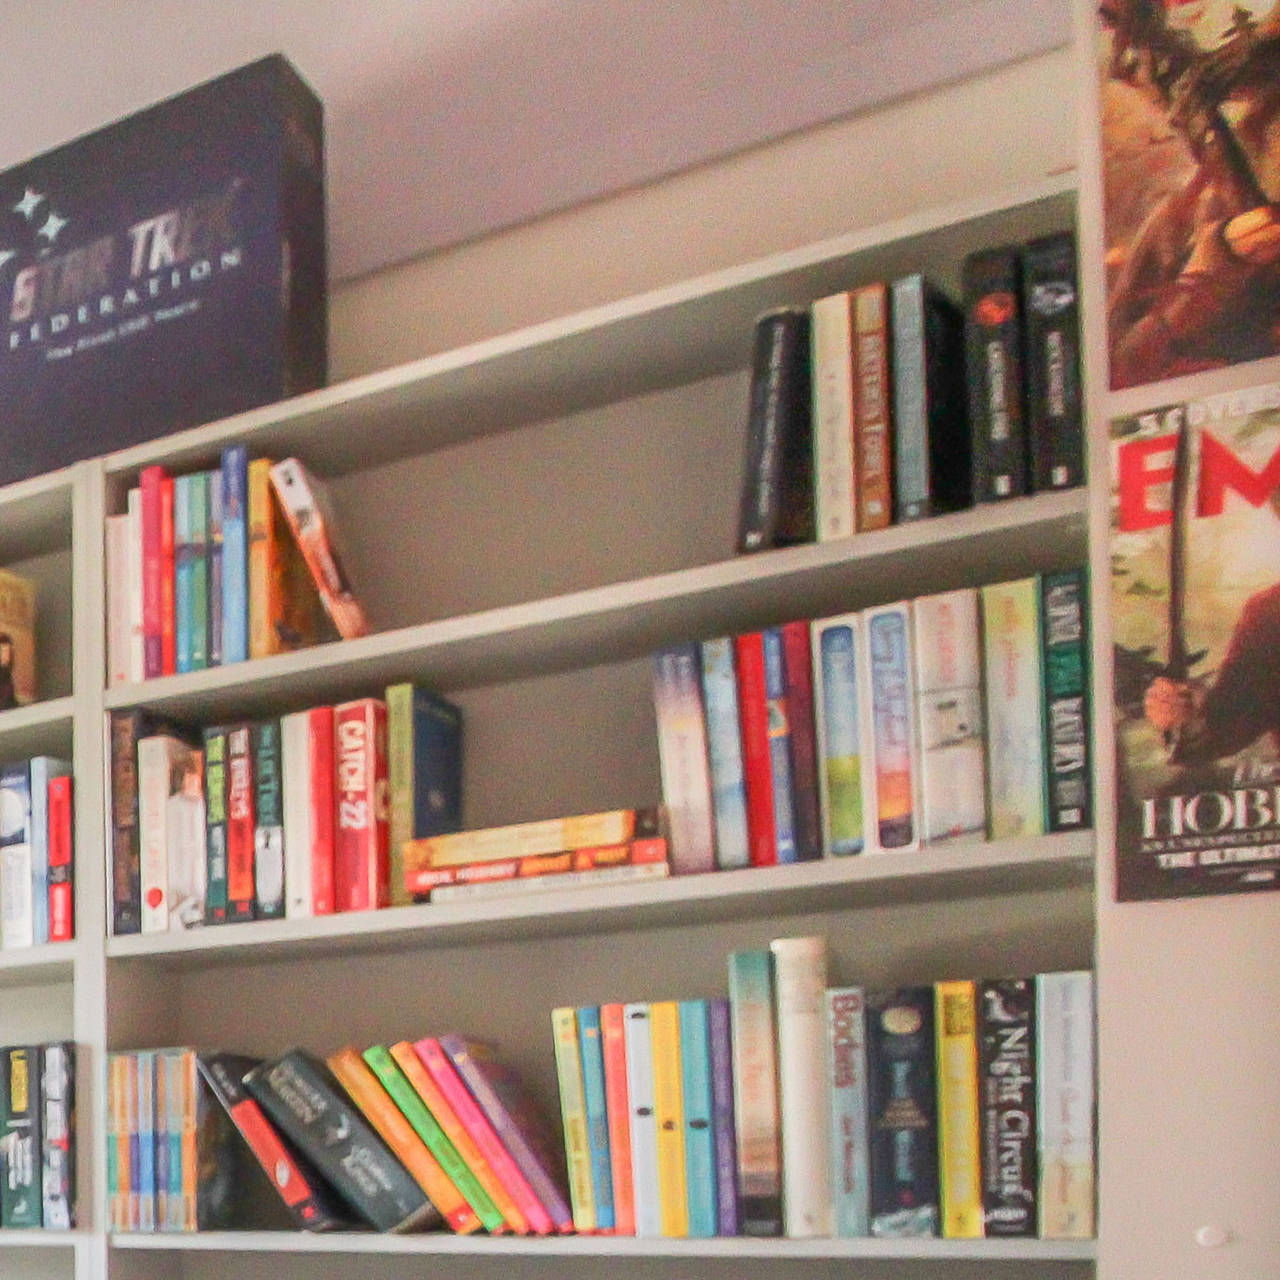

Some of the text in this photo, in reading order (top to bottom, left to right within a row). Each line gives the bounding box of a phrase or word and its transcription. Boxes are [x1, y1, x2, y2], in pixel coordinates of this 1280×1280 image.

[9, 248, 241, 348] FEDERATION
[338, 720, 369, 830] CATCH-22
[1142, 788, 1280, 840] HOB
[990, 1026, 1032, 1103] Night
